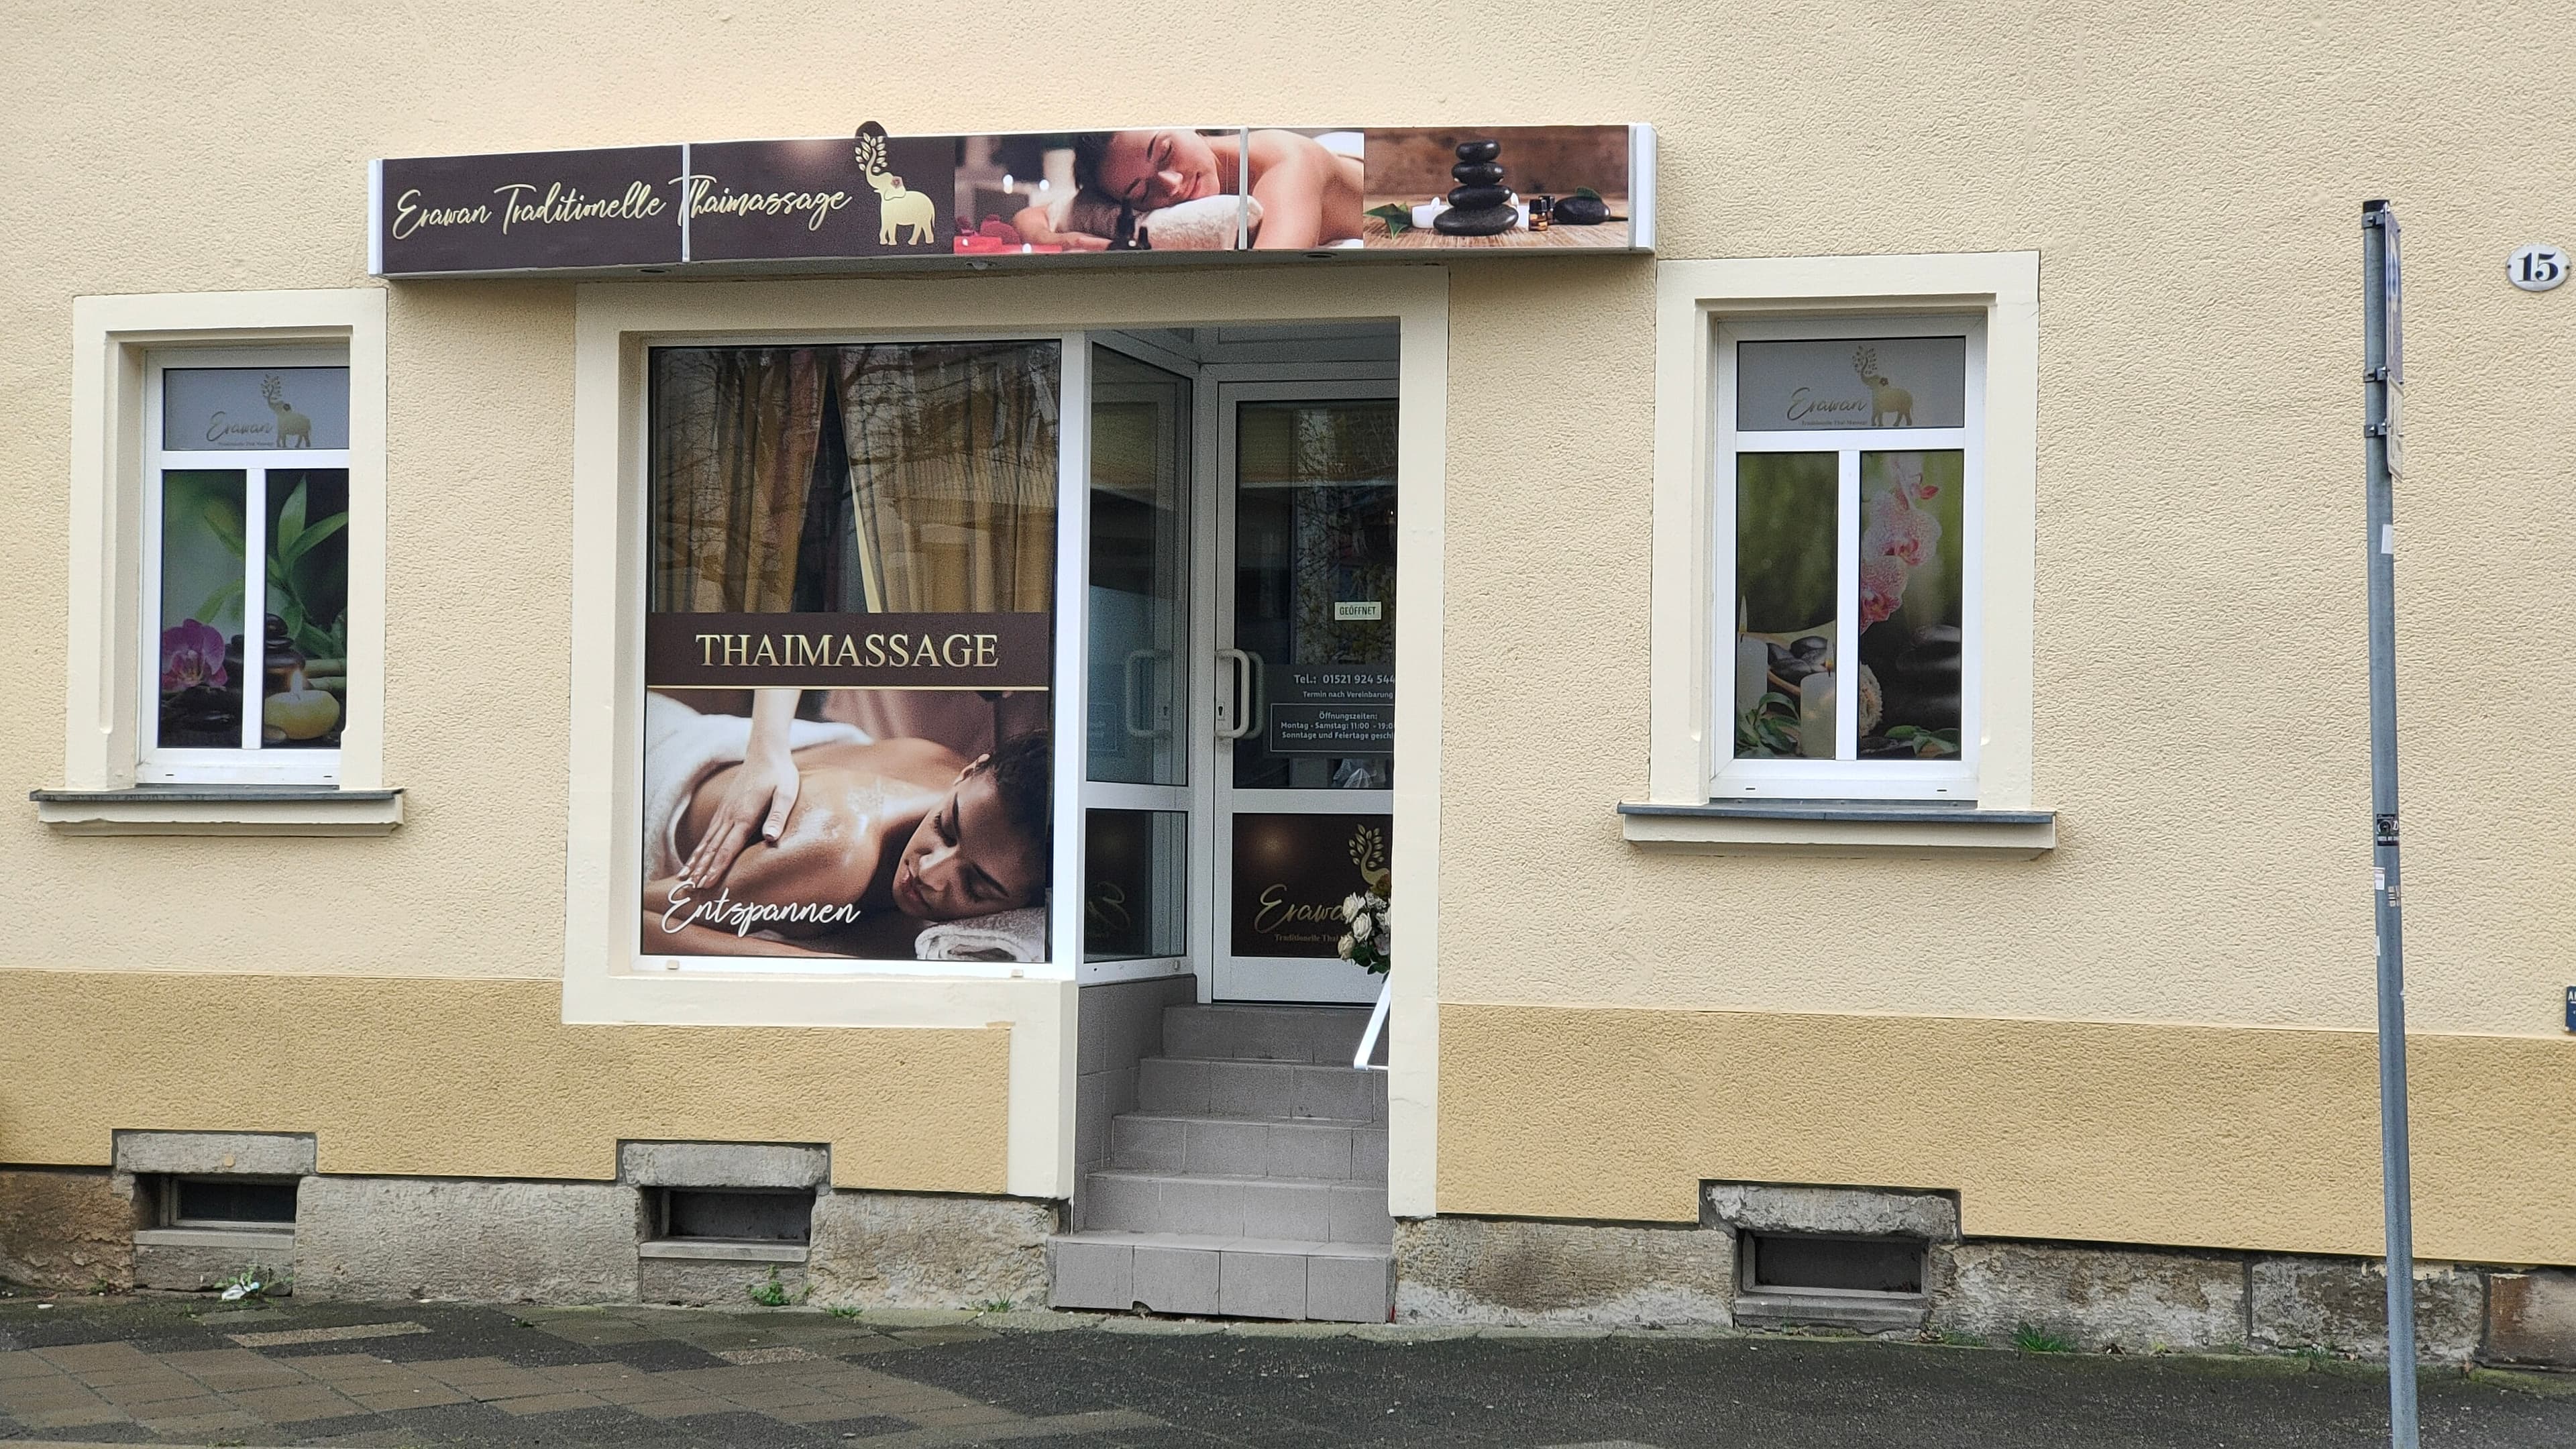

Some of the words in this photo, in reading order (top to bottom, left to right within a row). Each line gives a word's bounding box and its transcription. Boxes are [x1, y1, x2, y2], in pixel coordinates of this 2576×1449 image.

[392, 189, 492, 240] Erawan
[668, 174, 853, 231] Thaimassage
[2517, 252, 2559, 282] 15
[1786, 386, 1867, 421] Erawan
[1339, 605, 1377, 616] GEÖFFNET
[695, 633, 999, 668] THAIMASSAGE
[1293, 673, 1317, 684] Tel.:
[1322, 674, 1351, 684] 01521
[1354, 674, 1373, 684] 924
[1303, 690, 1326, 698] Termin
[1328, 690, 1345, 698] nach
[1346, 690, 1393, 699] Vereinbarung
[1319, 710, 1377, 720] Öffnungszeiten:
[1281, 721, 1309, 730] Montag
[1315, 722, 1349, 730] Samstag:
[1350, 722, 1370, 730] 11:00
[1378, 722, 1393, 730] 19:0
[1282, 731, 1317, 740] Sonntage
[1335, 731, 1369, 741] Feiertage
[1371, 731, 1393, 741] geschl
[660, 879, 861, 938] Entspannen
[1254, 883, 1344, 934] Erawa
